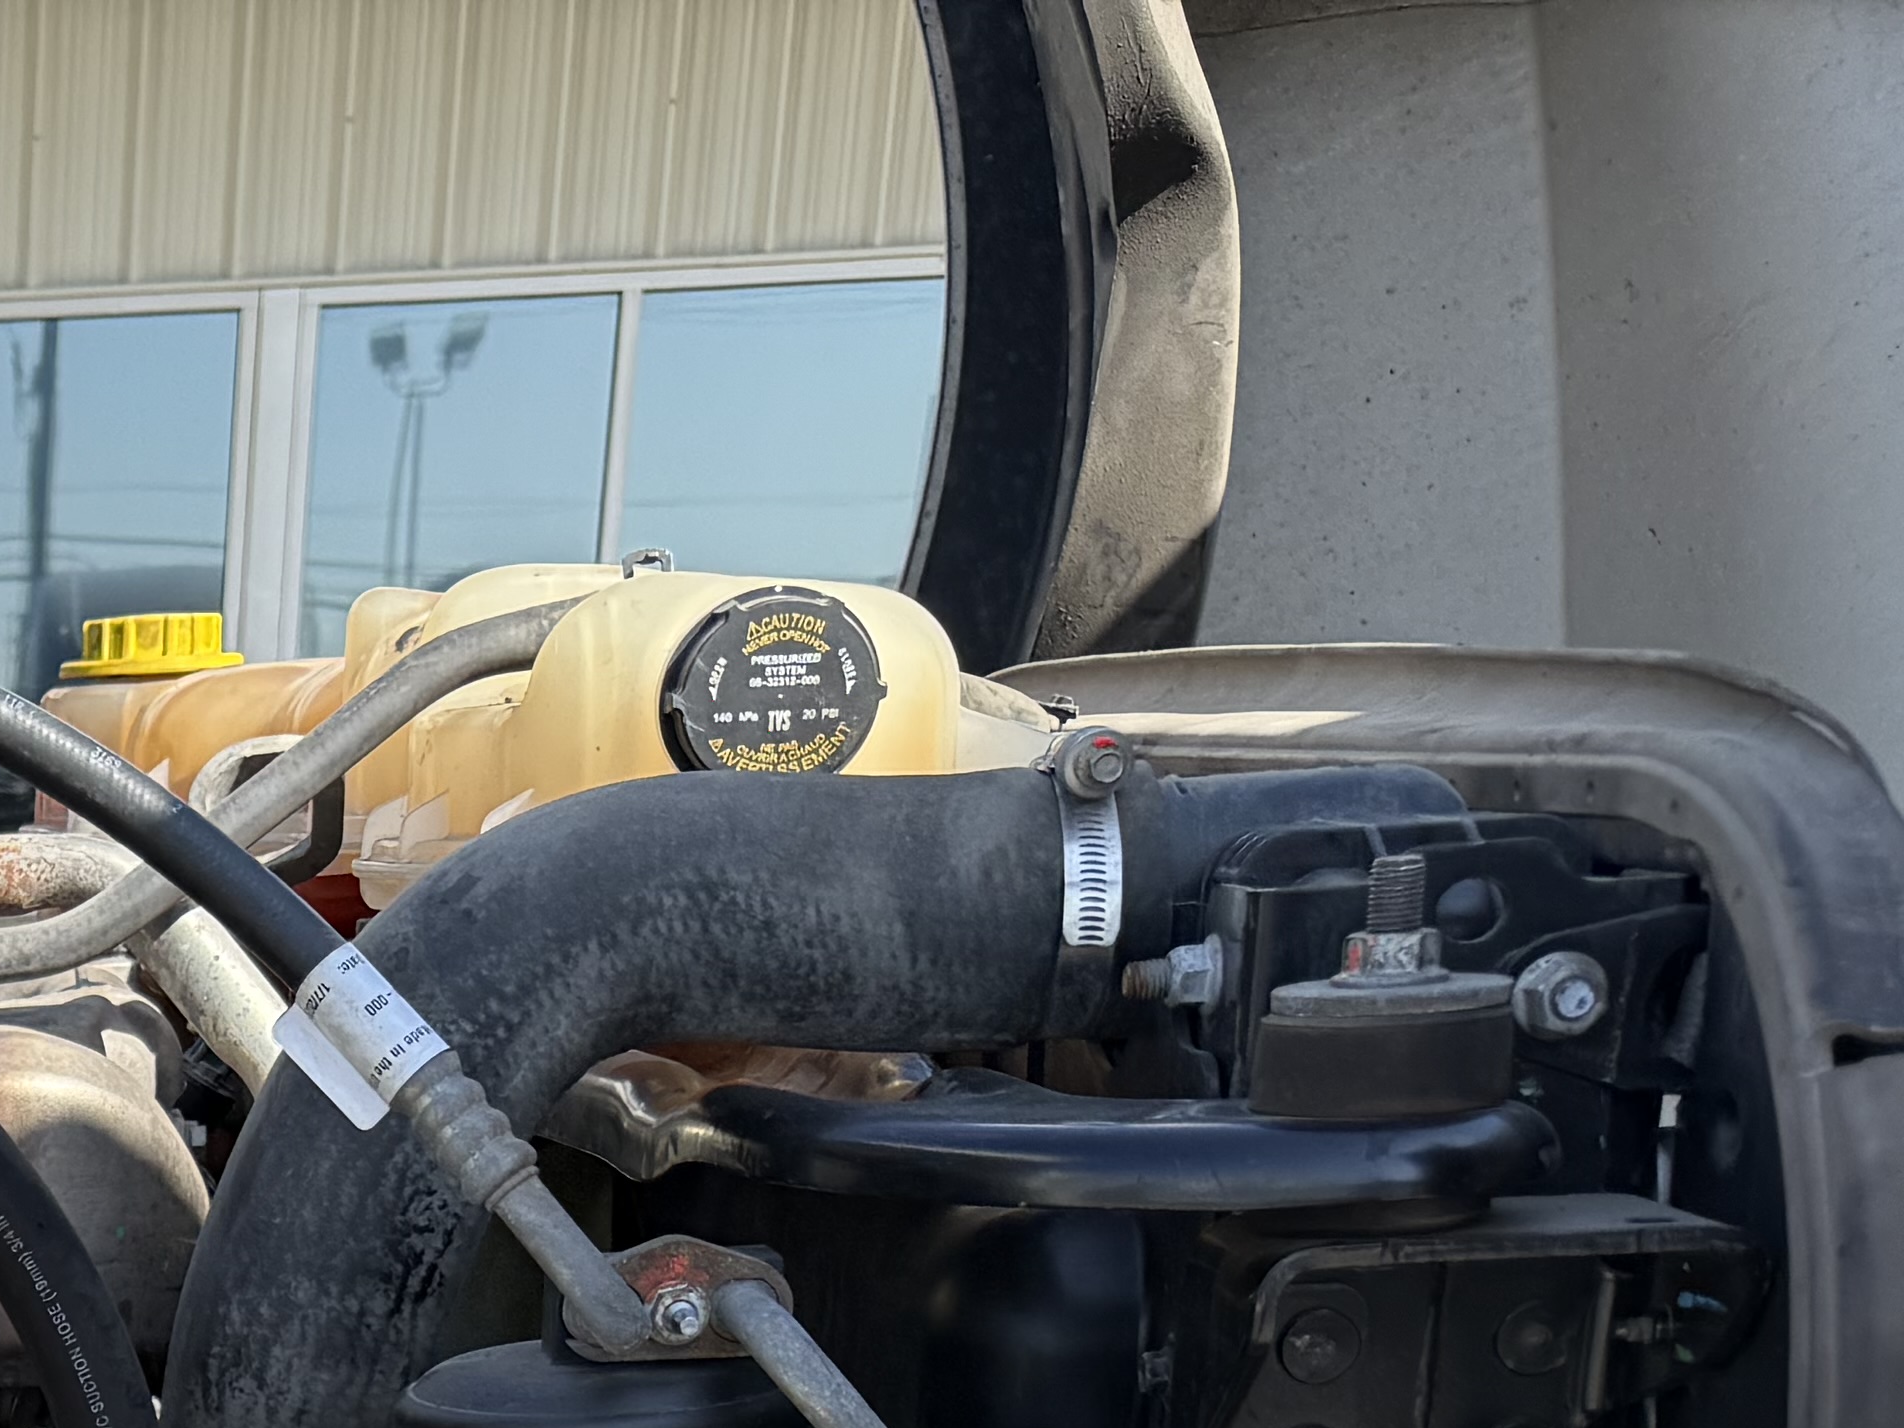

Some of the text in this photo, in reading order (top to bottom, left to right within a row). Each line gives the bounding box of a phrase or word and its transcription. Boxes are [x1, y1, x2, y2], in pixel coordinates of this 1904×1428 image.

[761, 612, 826, 635] CAUTION
[742, 629, 831, 656] NEVER OPEN HOT
[750, 653, 822, 666] PRESSURIZED
[764, 665, 807, 676] SYSTEM
[713, 712, 733, 723] 140
[768, 710, 792, 732] TVS
[802, 708, 840, 720] 20 PSI
[5, 1228, 24, 1253] 3/4
[17, 1250, 58, 1304] (19mm)
[46, 1302, 77, 1346] HOSE
[69, 1347, 106, 1414] SUCTION
